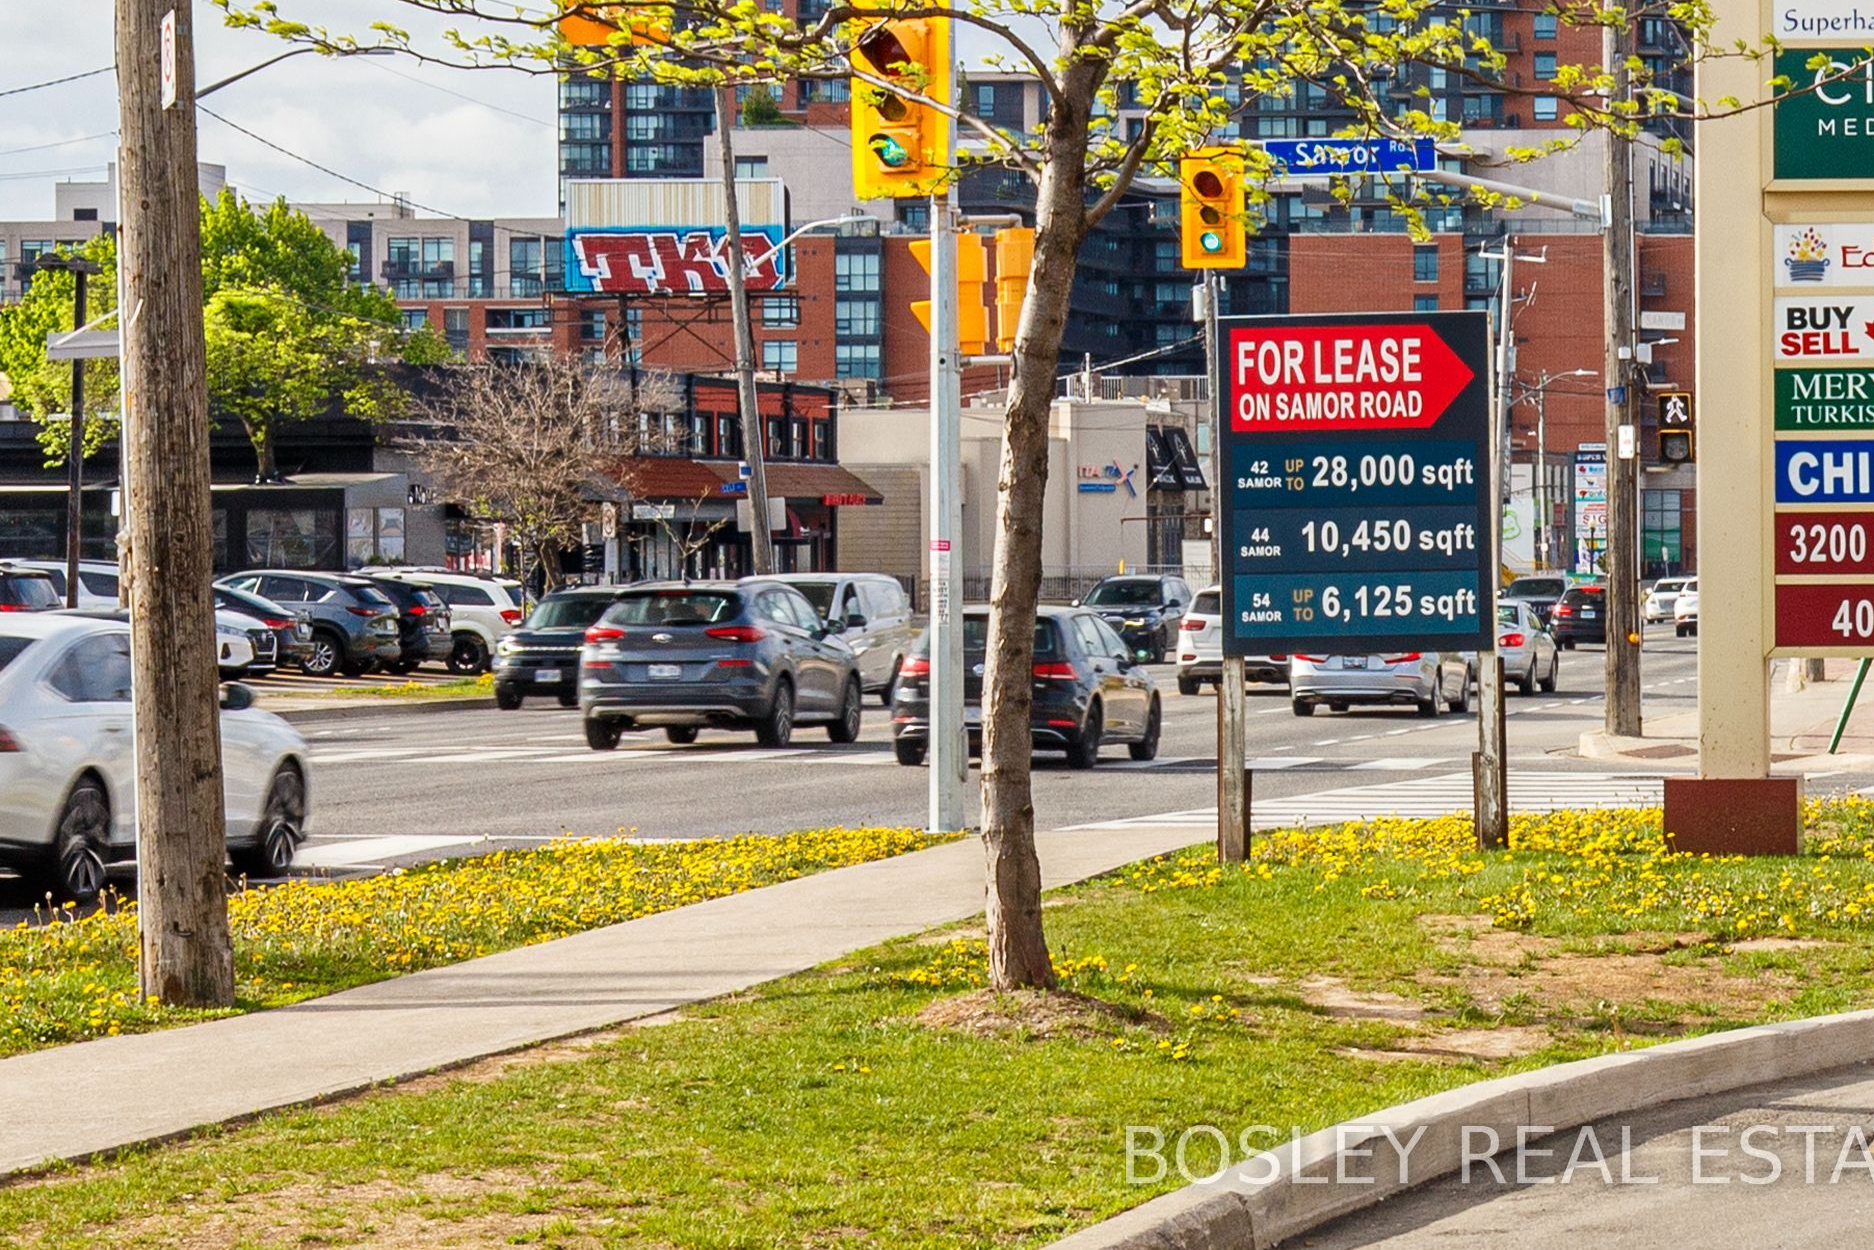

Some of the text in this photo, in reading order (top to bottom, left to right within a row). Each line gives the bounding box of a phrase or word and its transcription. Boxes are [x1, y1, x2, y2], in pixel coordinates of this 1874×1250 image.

[1786, 306, 1855, 331] BUY
[1781, 332, 1859, 356] SELL
[1238, 338, 1422, 385] FOR LEASE
[1239, 390, 1423, 421] ON SAMOR ROAD
[1250, 461, 1269, 474] 42
[1285, 459, 1304, 473] UP
[1312, 454, 1415, 491] 28,000
[1422, 458, 1474, 491] sqft
[1237, 476, 1282, 489] SAMOR
[1286, 477, 1304, 491] TO
[1251, 527, 1270, 542] 44
[1302, 519, 1476, 558] 10,450 sqft
[1240, 545, 1281, 557] SAMOR
[1790, 524, 1866, 563] 3200
[1252, 593, 1271, 608] 54
[1293, 589, 1313, 604] UP
[1321, 585, 1477, 622] 6,125 sqft
[1241, 610, 1282, 623] SAMOR
[1293, 607, 1314, 622] TO
